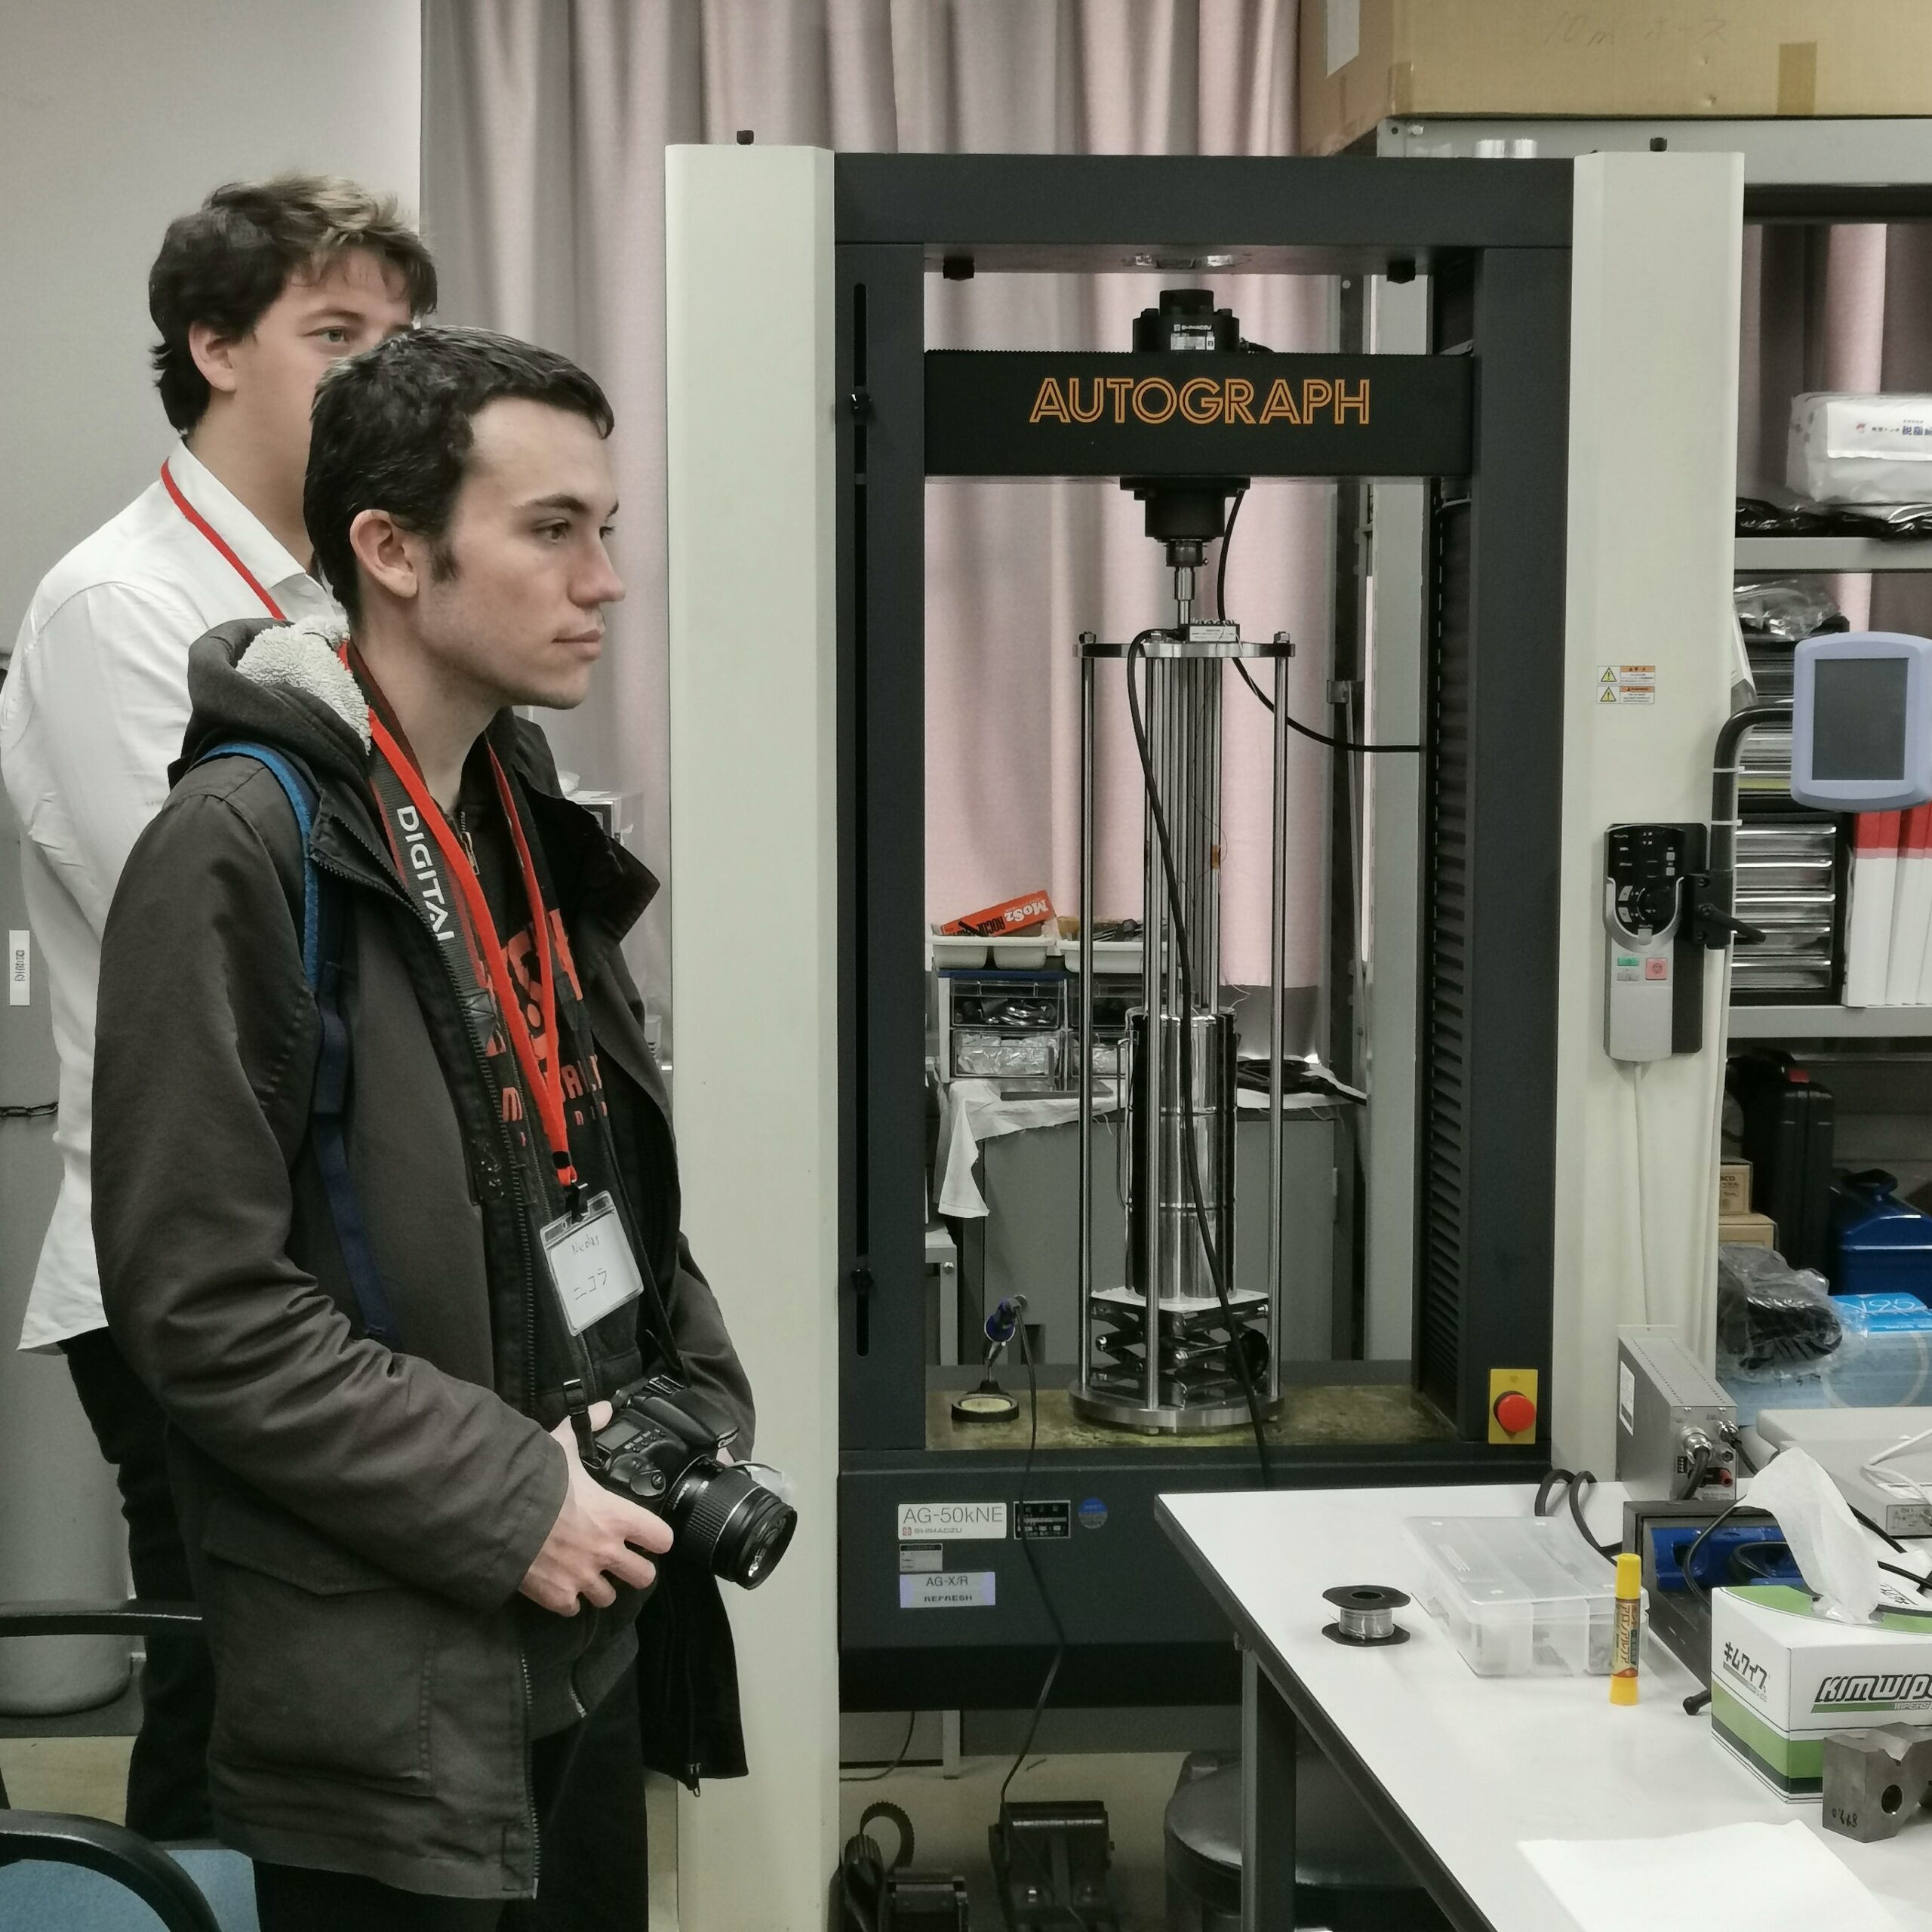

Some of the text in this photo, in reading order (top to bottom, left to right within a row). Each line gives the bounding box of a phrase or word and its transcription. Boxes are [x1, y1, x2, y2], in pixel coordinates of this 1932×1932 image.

[1029, 377, 1370, 425] AUTOGRAPH
[574, 1267, 608, 1301] ニコラ
[903, 1506, 1003, 1524] AG-50kNE
[926, 1576, 968, 1587] AG-X/R
[924, 1595, 972, 1603] REFRESH
